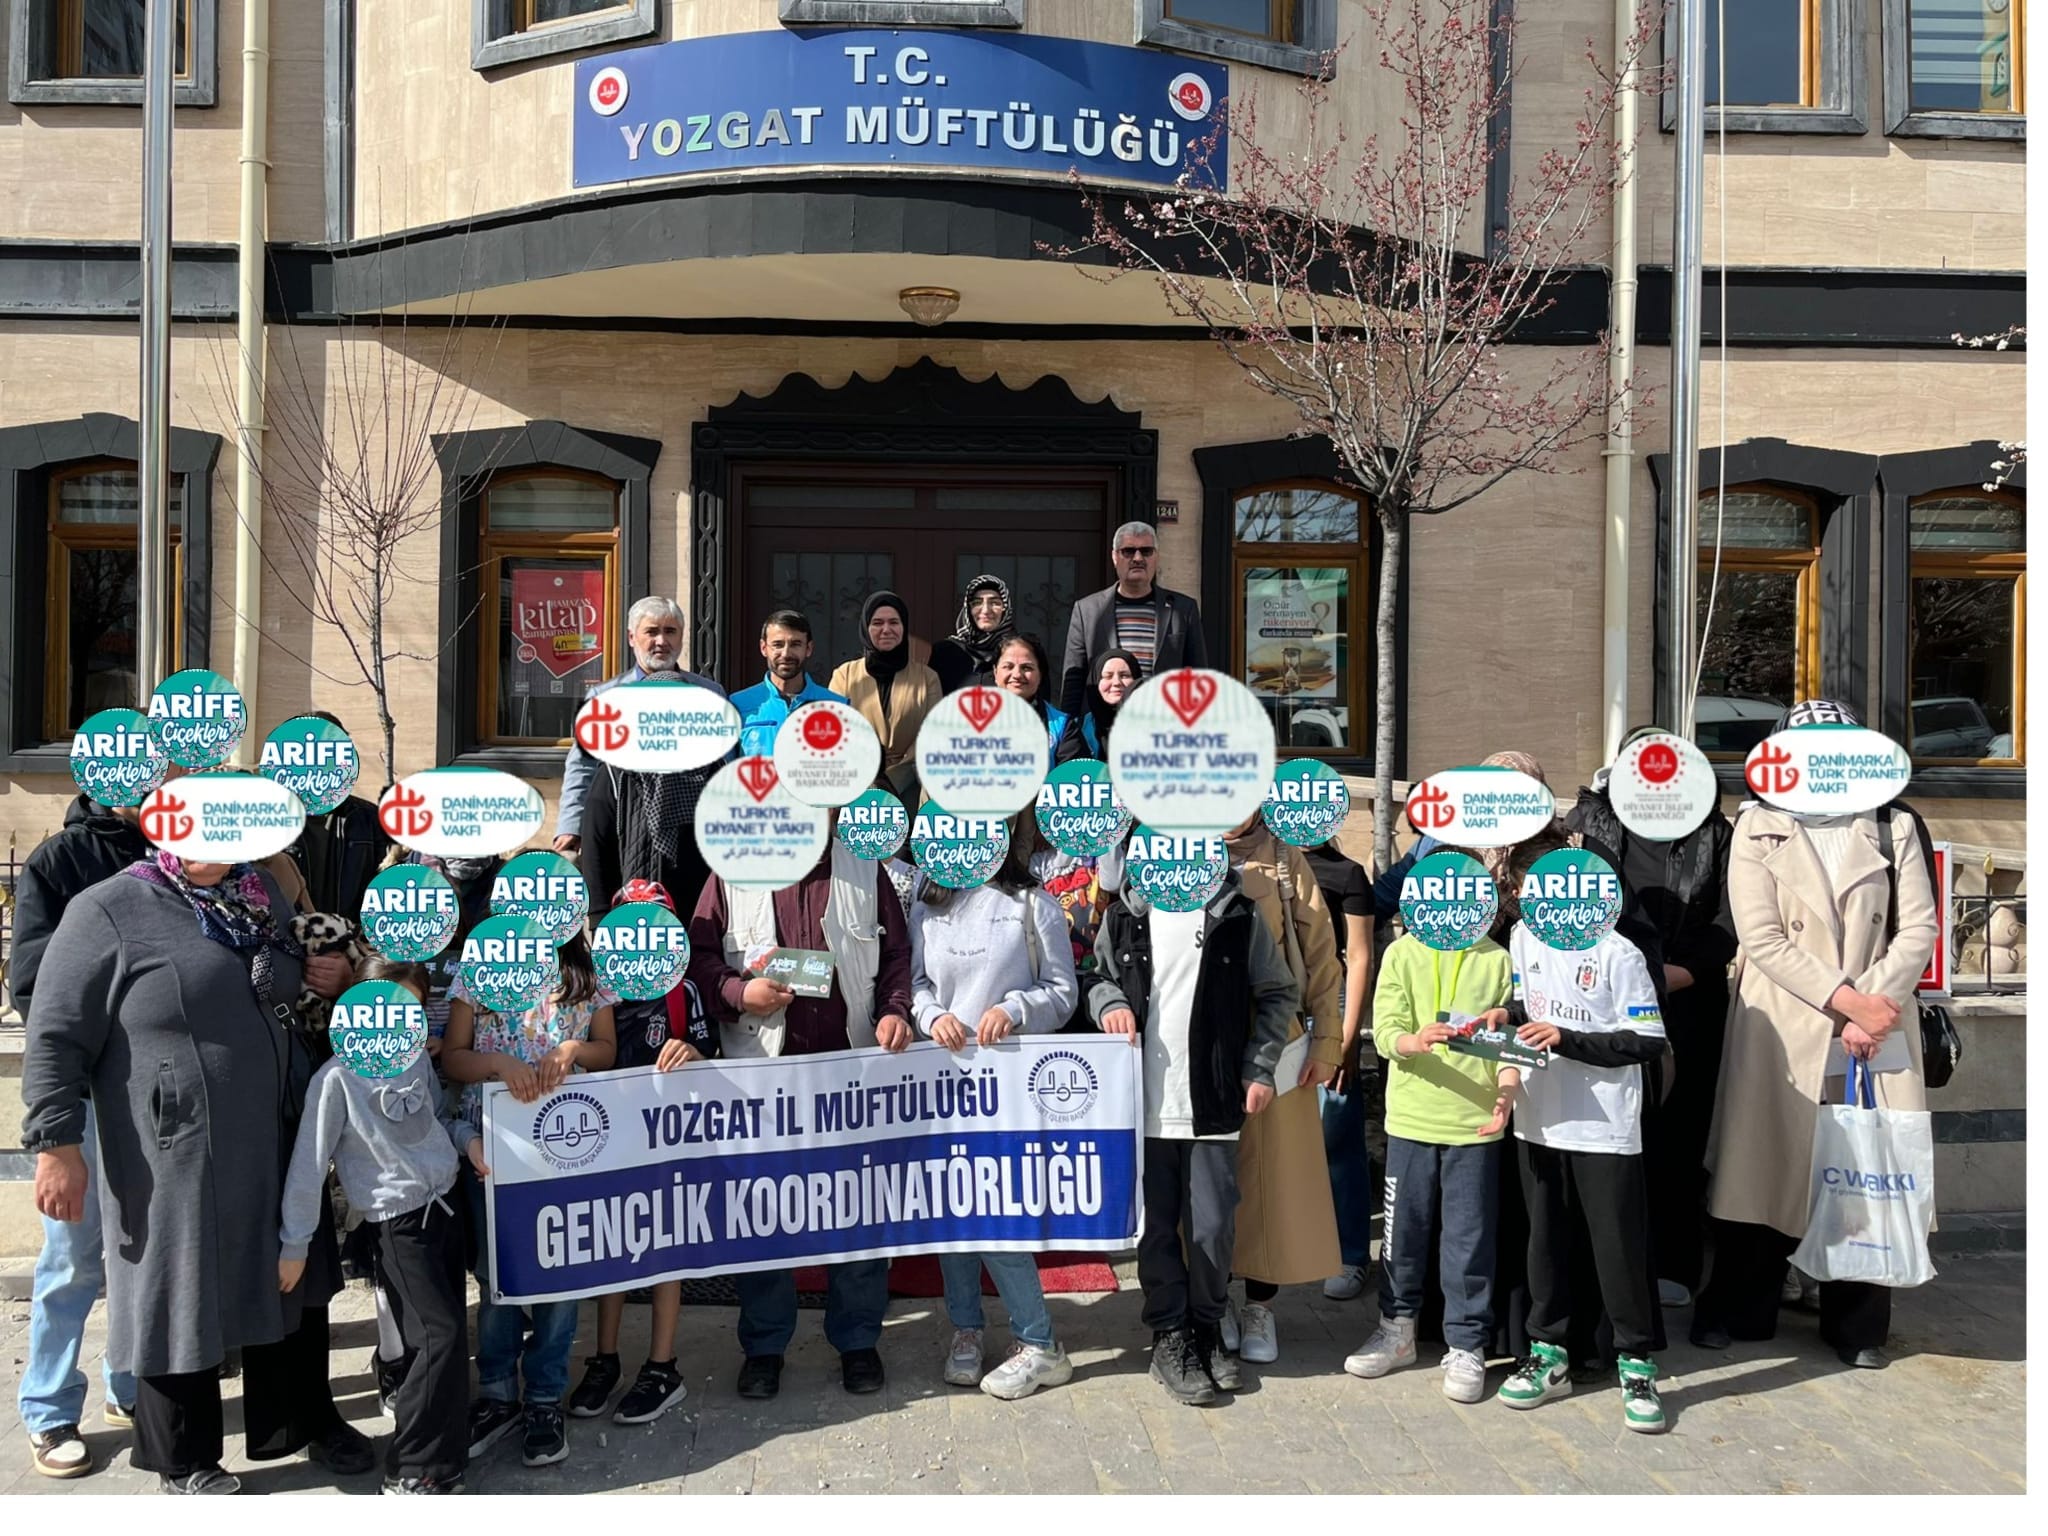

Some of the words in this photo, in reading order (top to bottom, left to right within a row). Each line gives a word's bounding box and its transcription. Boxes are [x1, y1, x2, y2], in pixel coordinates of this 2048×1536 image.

[844, 46, 946, 85] T.C.
[620, 105, 822, 161] YOZGAT
[845, 96, 1180, 167] MÜFTÜLÜĞÜ
[519, 599, 597, 640] kitap
[1550, 1000, 1592, 1022] Rain
[641, 1097, 765, 1150] YOZGAT
[775, 1090, 803, 1137] İL
[813, 1068, 999, 1132] MÜFTÜLÜĞÜ
[536, 1171, 712, 1270] GENÇLİK
[725, 1140, 1101, 1241] KOORDİNATÖRLÜĞÜ
